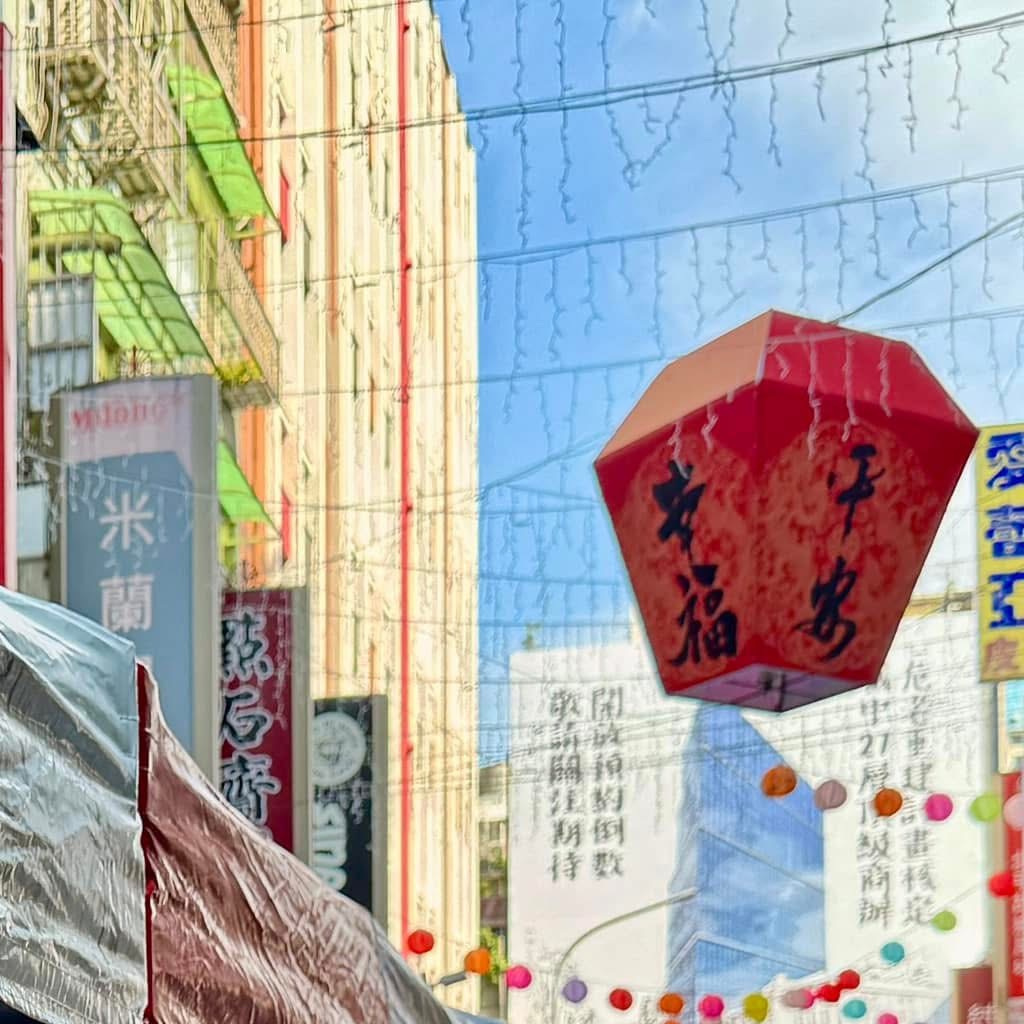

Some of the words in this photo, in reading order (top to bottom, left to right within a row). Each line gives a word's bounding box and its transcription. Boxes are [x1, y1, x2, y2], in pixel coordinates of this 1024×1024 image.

[99, 491, 155, 668] 米蘭
[652, 459, 738, 667] 幸福
[794, 444, 884, 662] 平安
